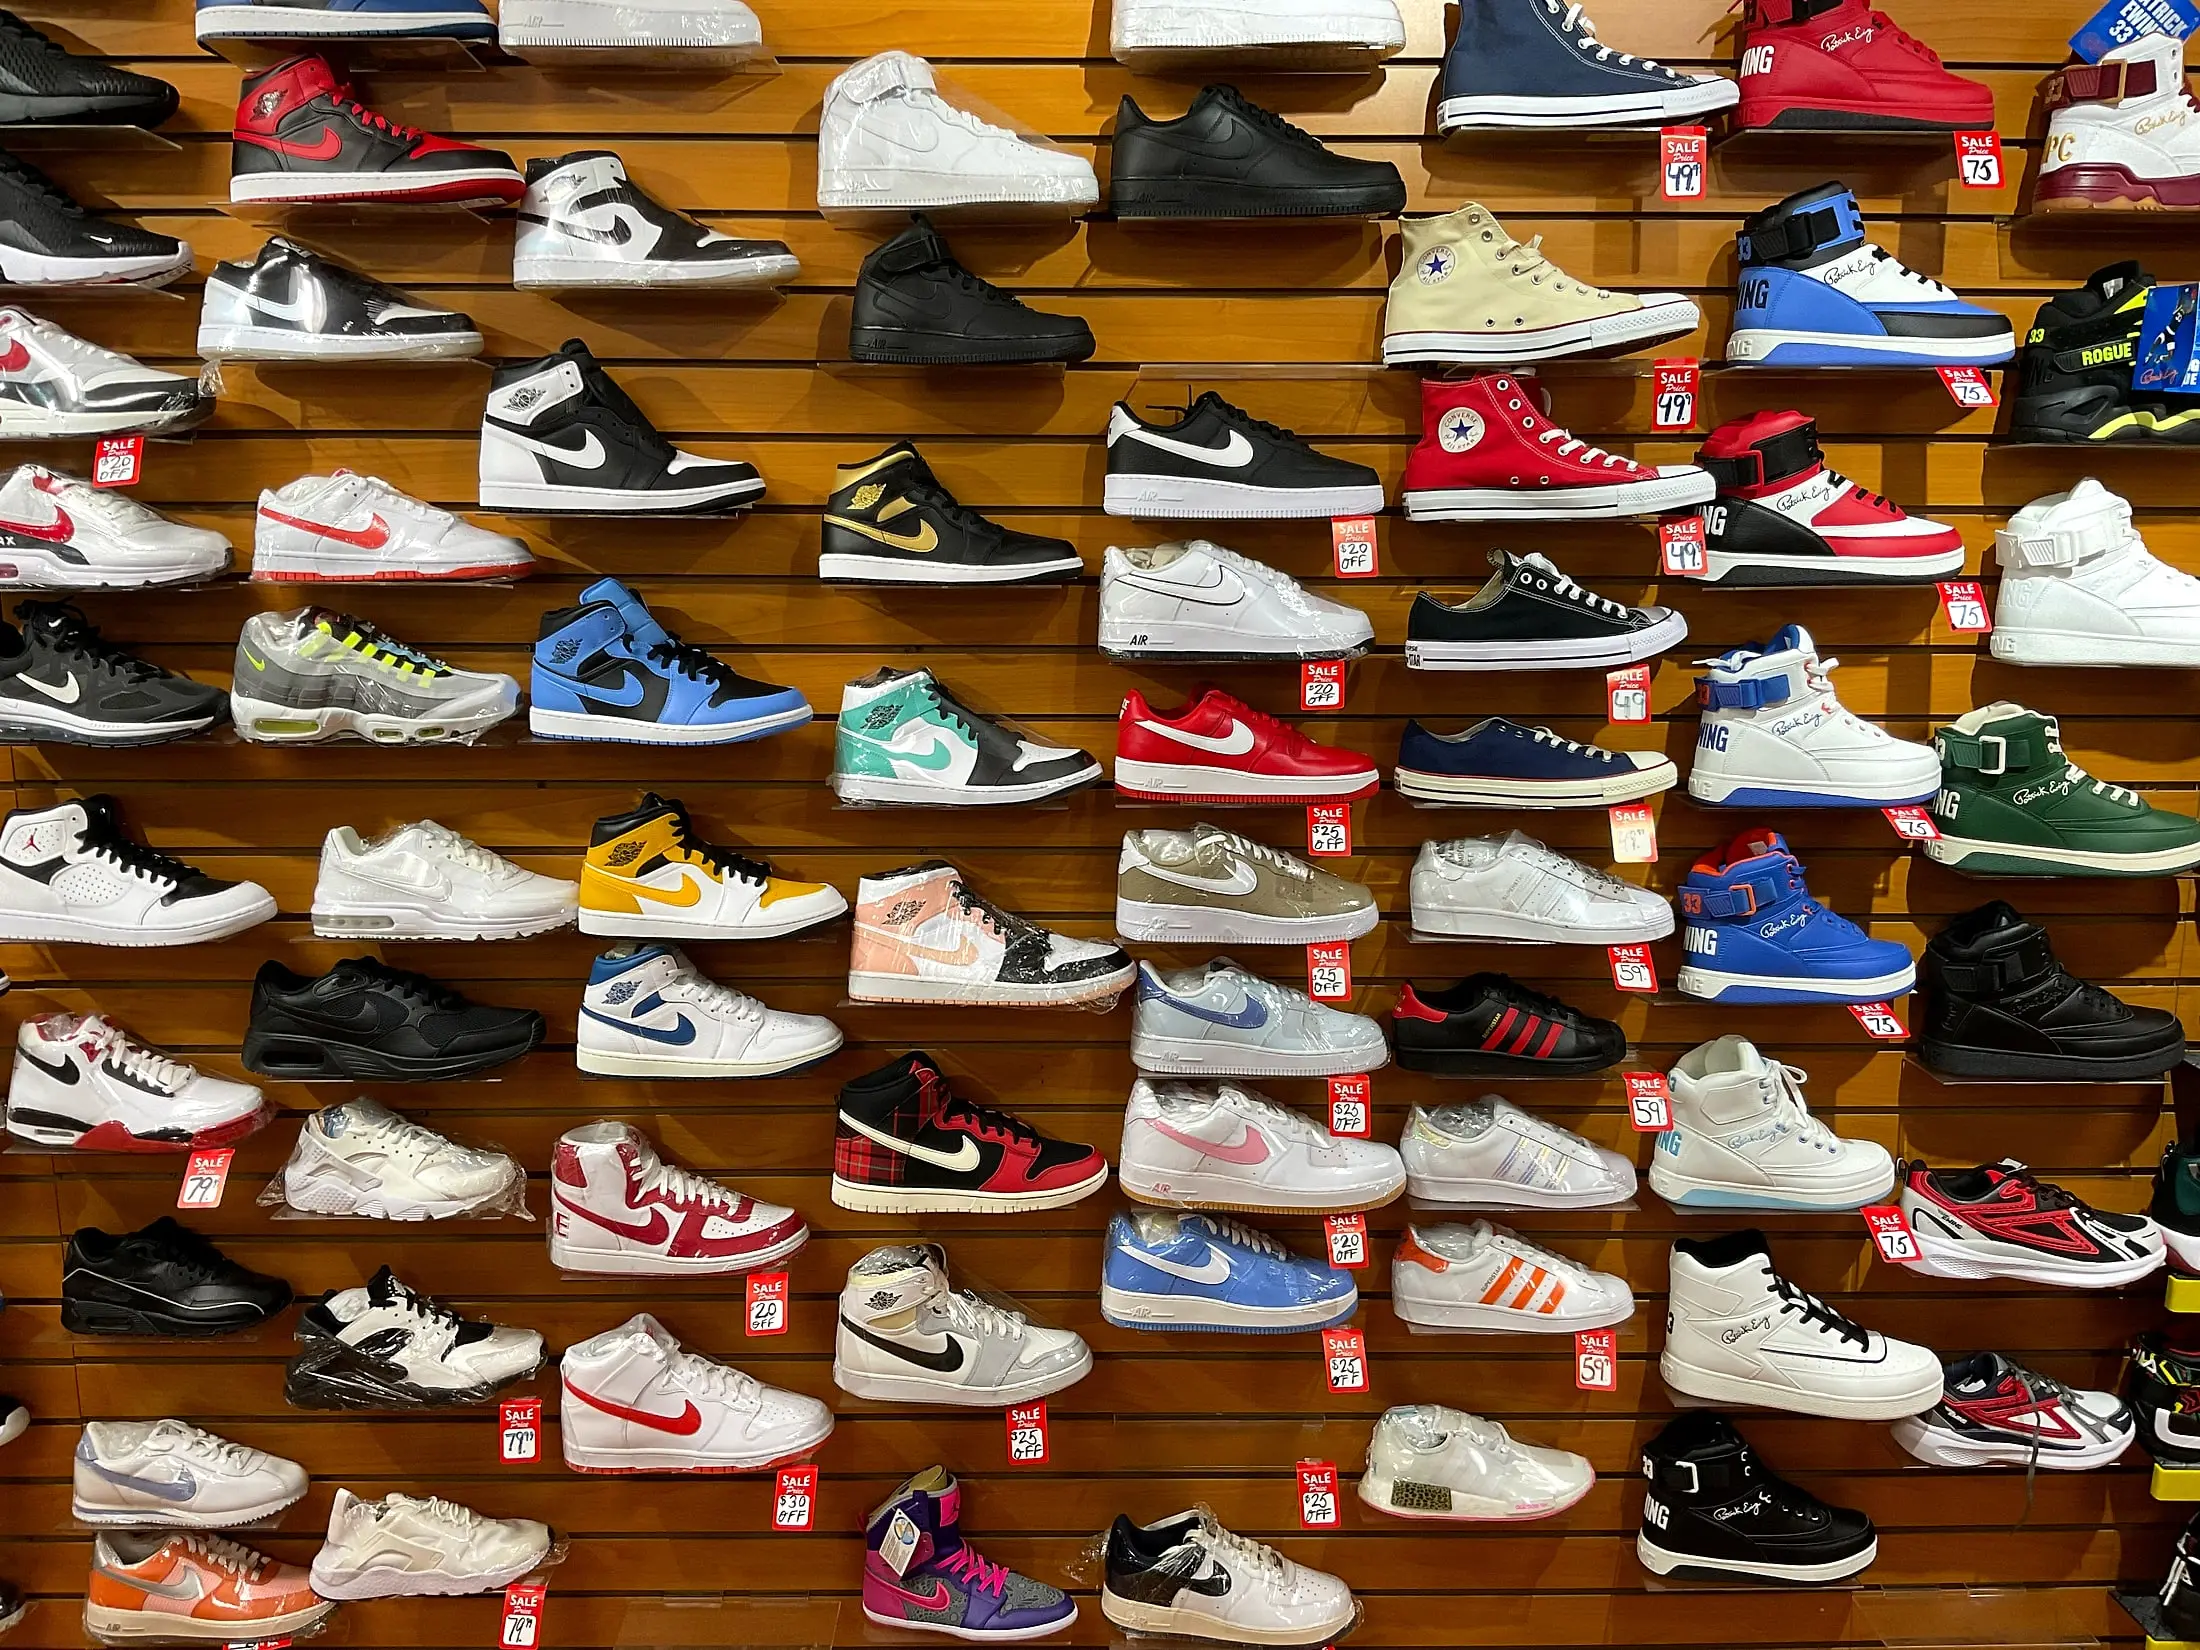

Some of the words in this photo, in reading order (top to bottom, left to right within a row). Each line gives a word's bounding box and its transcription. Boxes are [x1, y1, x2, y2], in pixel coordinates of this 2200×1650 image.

[2109, 20, 2133, 43] 33
[1667, 140, 1699, 153] SALE
[1961, 136, 1993, 147] SALE
[2081, 342, 2132, 367] ROGUE
[1660, 371, 1692, 384] SALE
[1944, 368, 1976, 378] SALE
[1444, 412, 1478, 428] CONVERSE
[103, 439, 135, 451] SALE
[1340, 523, 1369, 534] SALE
[1666, 522, 1697, 534] SALE
[1944, 584, 1976, 595] SALE
[1950, 604, 1981, 626] 75
[1129, 634, 1149, 646] AIR
[1308, 665, 1338, 676] SALE
[1313, 808, 1342, 818] SALE
[1615, 810, 1645, 820] SALE
[1888, 807, 1920, 817] SALE
[1313, 949, 1342, 960] SALE
[1612, 947, 1644, 957] SALE
[1853, 1003, 1884, 1011] SALE
[1867, 1017, 1895, 1033] 75
[1334, 1083, 1363, 1094] SALE
[1631, 1078, 1660, 1089] SALE
[195, 1157, 224, 1169] SALE
[1151, 1182, 1172, 1195] AIR
[1330, 1216, 1358, 1226] SALE
[1871, 1214, 1900, 1225] SALE
[1881, 1235, 1908, 1255] 75
[1481, 1265, 1503, 1293] SUPERSTAR
[753, 1281, 782, 1293] SALE
[1329, 1338, 1358, 1349] SALE
[1581, 1335, 1609, 1347] SALE
[505, 1408, 534, 1420] SALE
[1012, 1408, 1040, 1421] SALE
[782, 1474, 810, 1486] SALE
[1303, 1472, 1331, 1484] SALE
[510, 1594, 538, 1606] SALE
